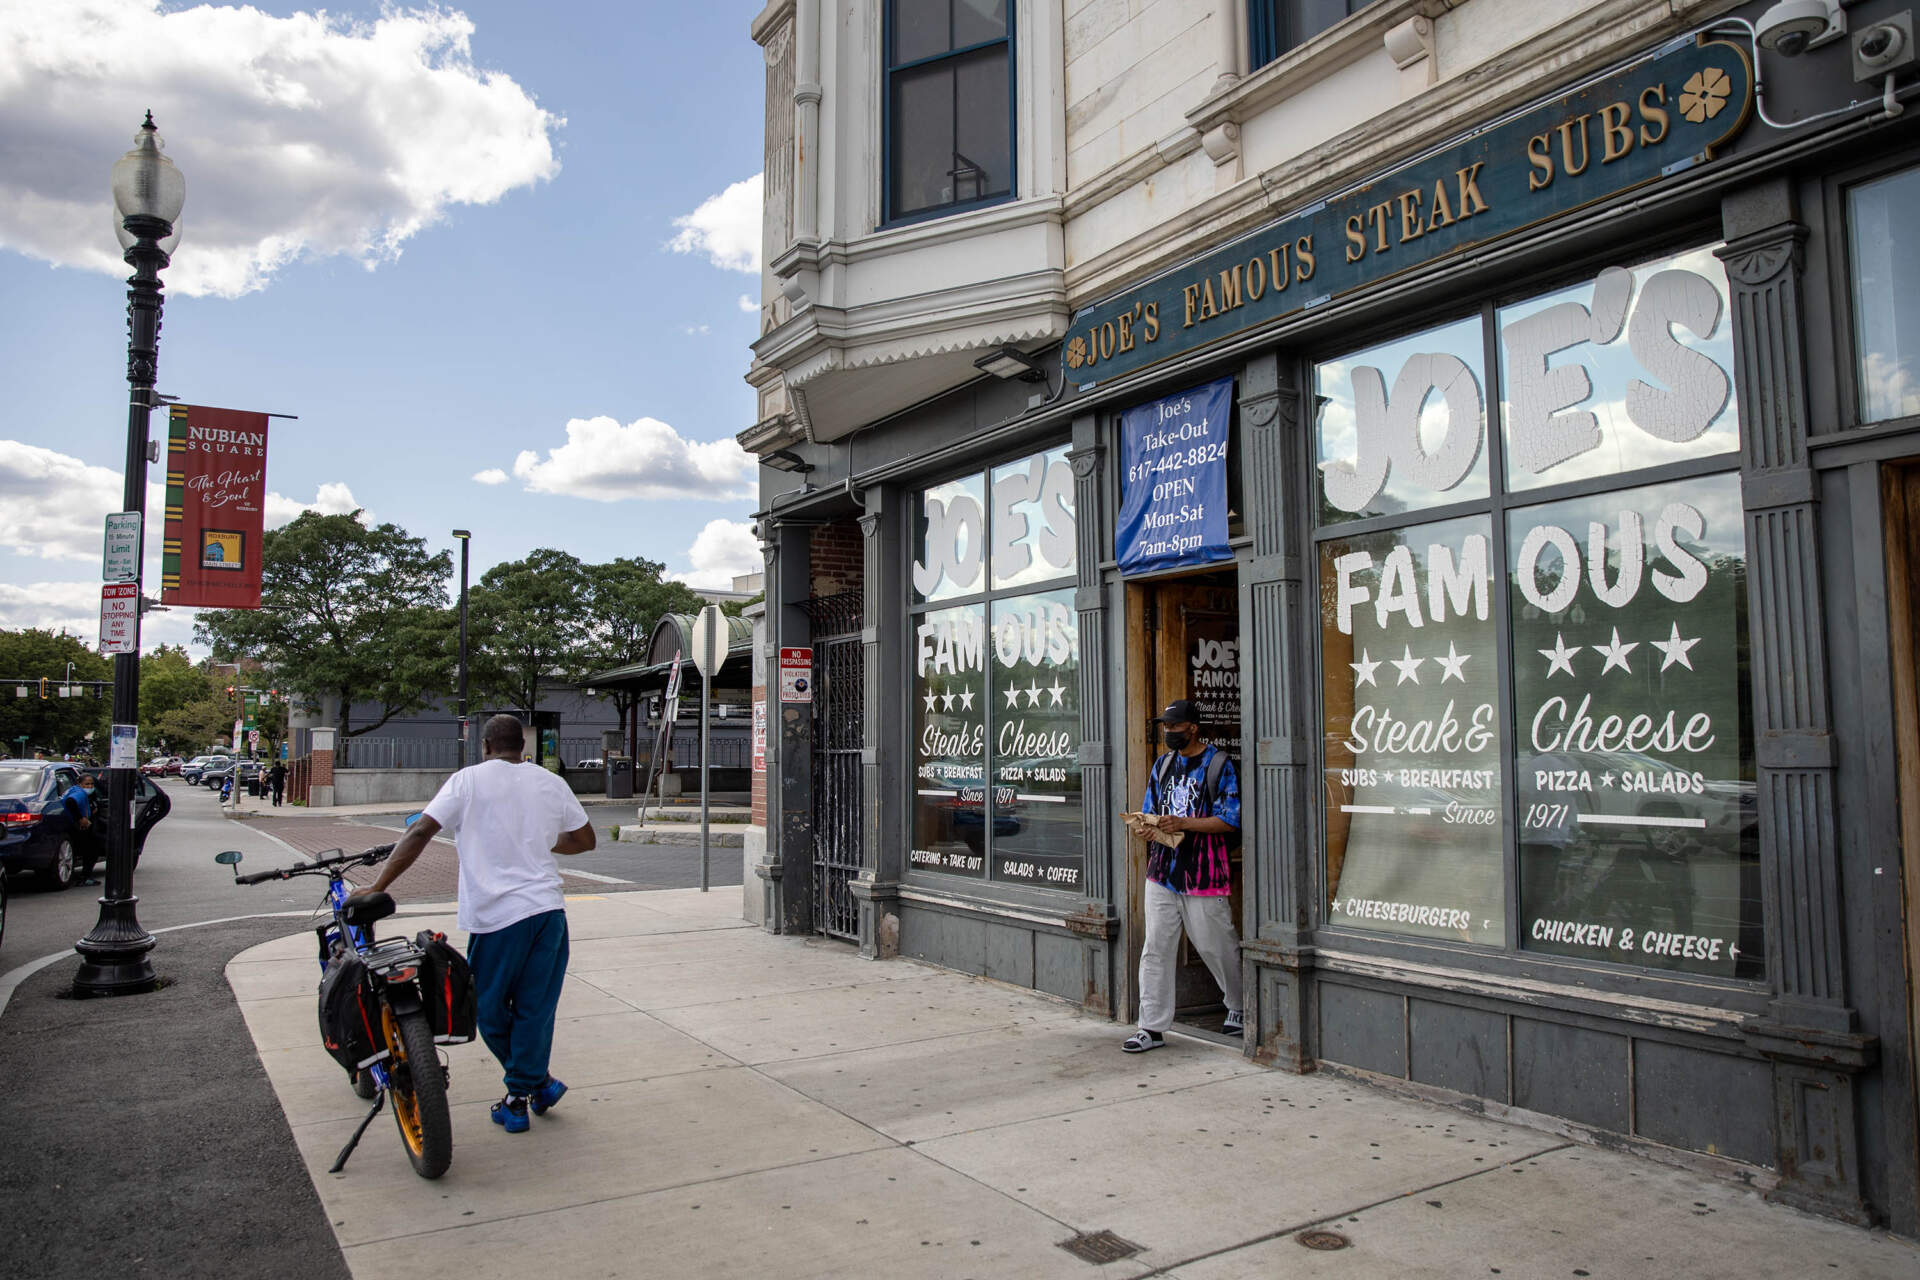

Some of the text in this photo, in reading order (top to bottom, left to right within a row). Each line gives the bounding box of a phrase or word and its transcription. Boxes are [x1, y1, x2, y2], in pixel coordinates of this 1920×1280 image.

[1087, 83, 1671, 366] JOE'S FAMOUS STEAK SUBS
[1323, 266, 1733, 512] JOE'S
[1158, 397, 1191, 425] Joe's
[188, 441, 264, 456] SQUARE
[189, 426, 264, 446] NUBIAN
[1143, 418, 1209, 453] Take-Out
[1129, 440, 1227, 483] 617-442-8824
[188, 469, 260, 492] The Heart
[1153, 476, 1195, 502] OPEN
[202, 492, 211, 503] &
[211, 486, 249, 508] Soul
[108, 520, 137, 531] Parking
[913, 453, 1076, 596] JOE'S
[1143, 503, 1204, 530] Mon-Sat
[111, 544, 130, 553] Limit
[1139, 534, 1203, 557] 7am-8pm
[1334, 503, 1708, 635] FAMOUS
[104, 587, 136, 596] TOW ZONE
[103, 611, 135, 620] STOPPING
[112, 601, 125, 611] NO
[111, 629, 126, 637] TIME
[917, 602, 1070, 678] FAMOUS
[782, 658, 812, 666] TRESPASSING
[791, 650, 801, 658] NO
[1343, 693, 1716, 754] Steak & Cheese
[920, 719, 1071, 757] Steak & Cheese
[918, 766, 1066, 782] SUBS BREAKFAST PIZZA SALADS
[1341, 768, 1705, 795] SUBS BREAKFAST PIZZA SALADS
[961, 787, 1014, 805] Since 1971
[1442, 800, 1569, 829] Since 1971
[910, 850, 1079, 884] CATERING TAKE OUT SALADS COFFEE
[1346, 898, 1723, 961] CHEESEBURGERS CHICKEN & CHEESE
